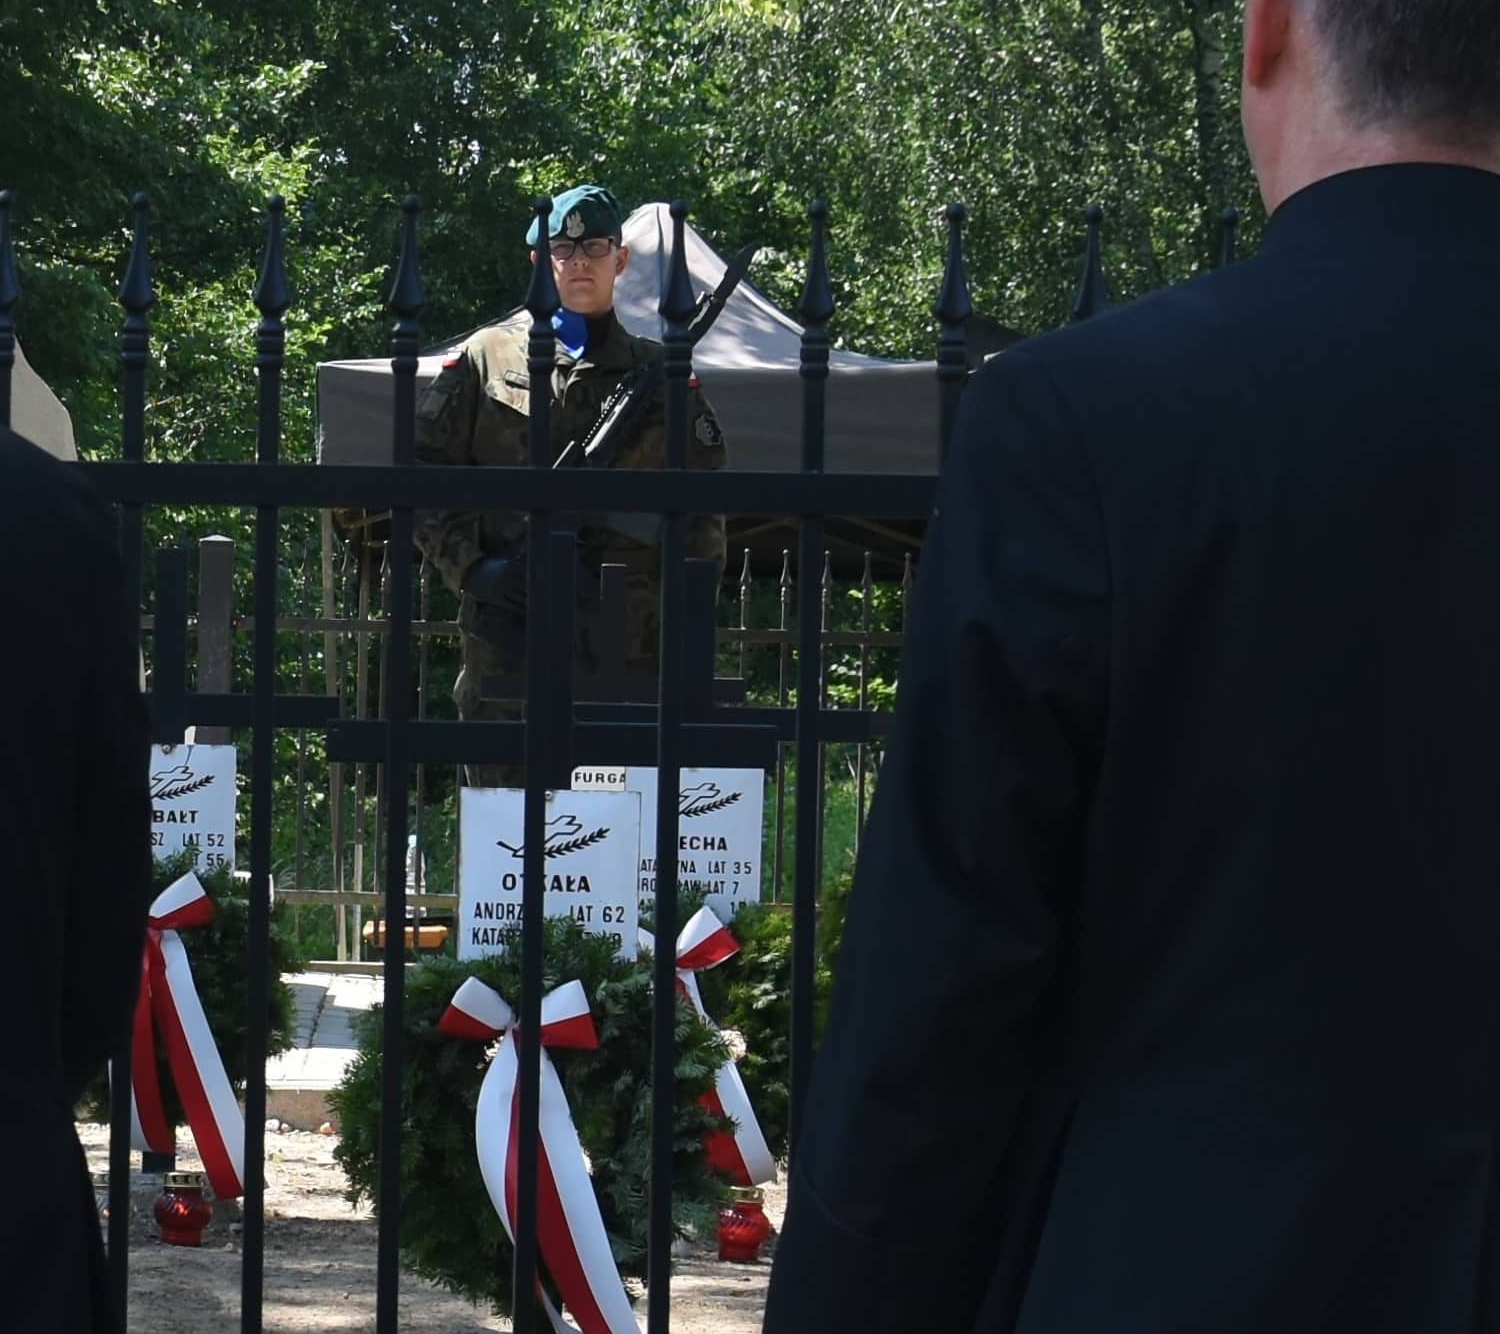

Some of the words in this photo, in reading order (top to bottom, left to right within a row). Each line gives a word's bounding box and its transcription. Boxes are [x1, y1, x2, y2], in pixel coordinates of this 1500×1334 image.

[182, 833, 202, 847] LAT
[207, 833, 225, 847] 52
[708, 860, 727, 875] LAT
[733, 861, 752, 875] 35
[732, 881, 740, 896] 7
[602, 906, 625, 924] 62
